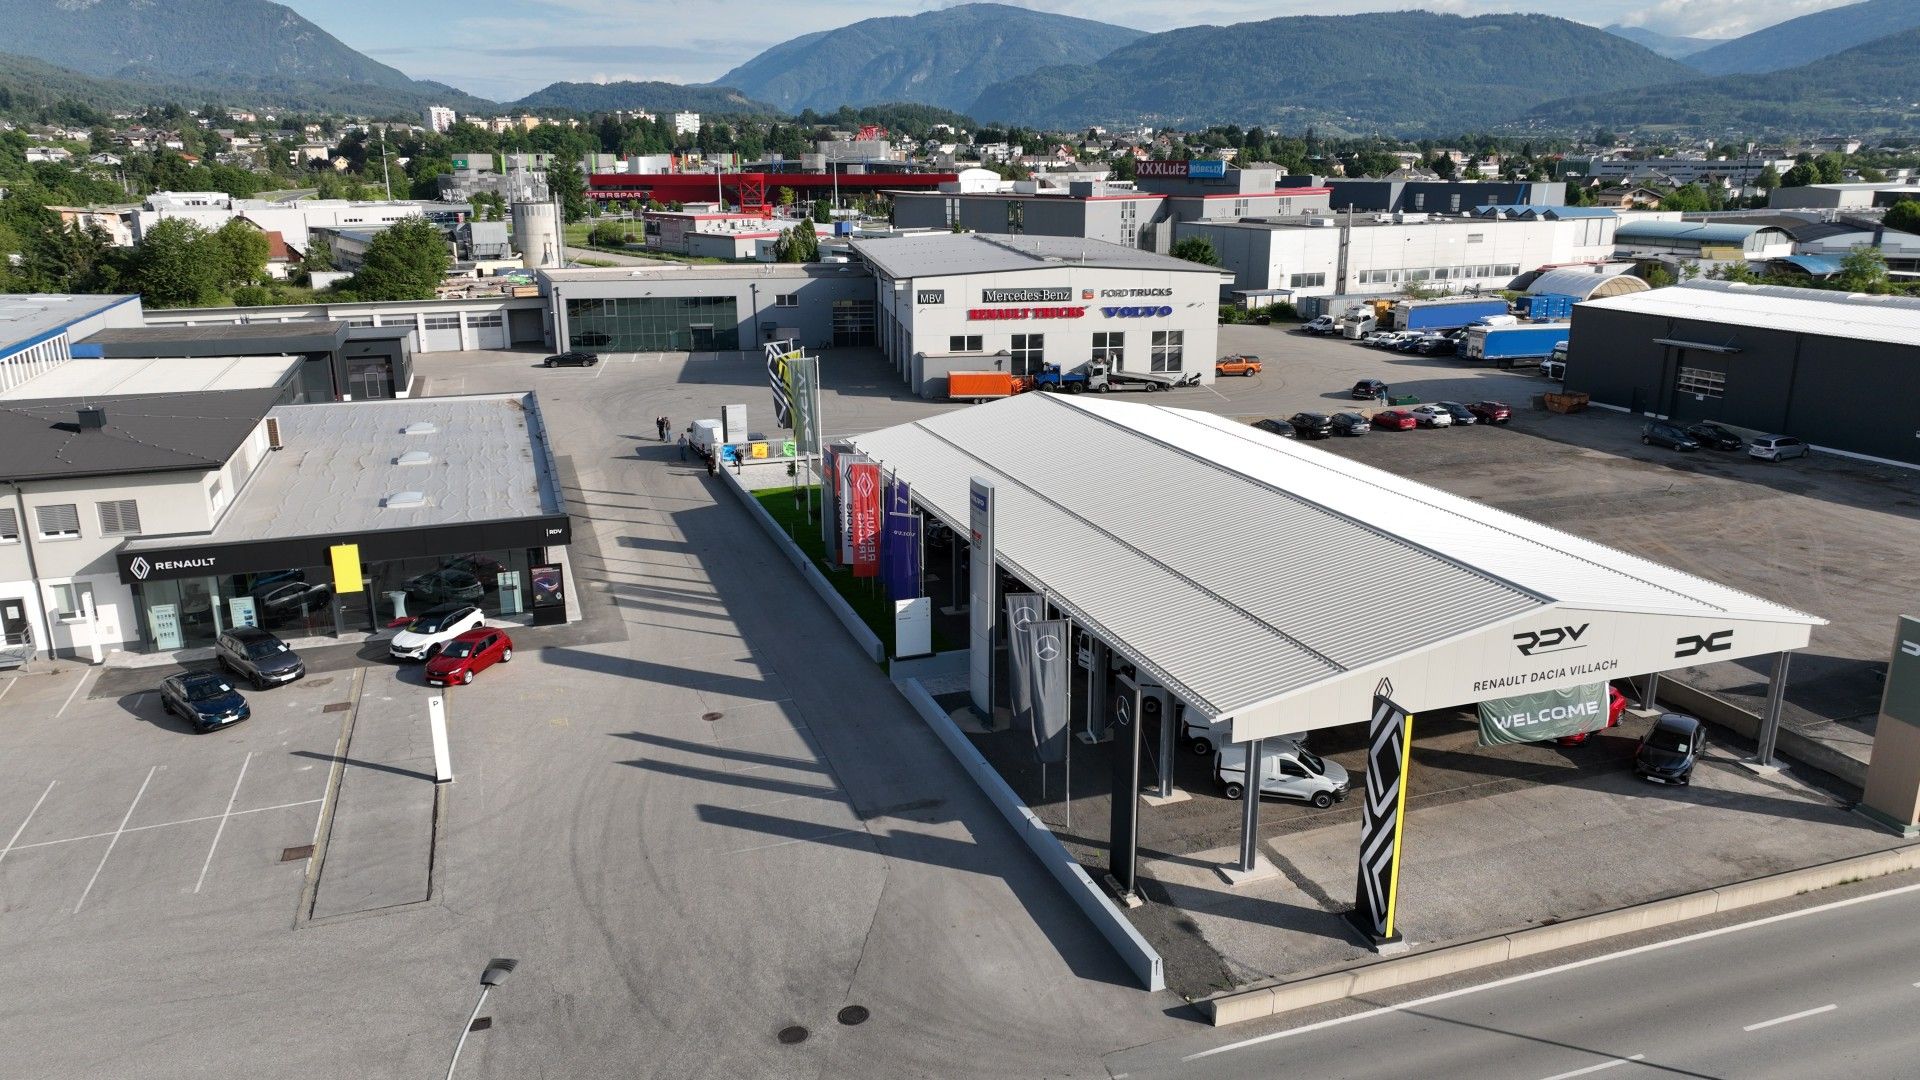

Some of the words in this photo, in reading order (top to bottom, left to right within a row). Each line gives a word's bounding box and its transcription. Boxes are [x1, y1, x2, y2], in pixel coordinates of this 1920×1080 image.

[1136, 162, 1187, 175] XXXLutz
[920, 293, 942, 303] MBV
[985, 289, 1070, 302] Mercedes-Benz
[1101, 289, 1128, 298] FORD
[1128, 287, 1173, 297] TRUCKS
[967, 308, 1030, 320] RENAULT
[1031, 306, 1085, 319] TRUCKS
[1100, 305, 1173, 318] VOLVO
[155, 557, 216, 571] RENAULT
[1513, 623, 1590, 656] RDV
[1473, 673, 1527, 692] RENAULT
[1530, 669, 1567, 683] DACIA
[1570, 659, 1618, 676] VILLACH
[1493, 701, 1600, 730] WELCOME
